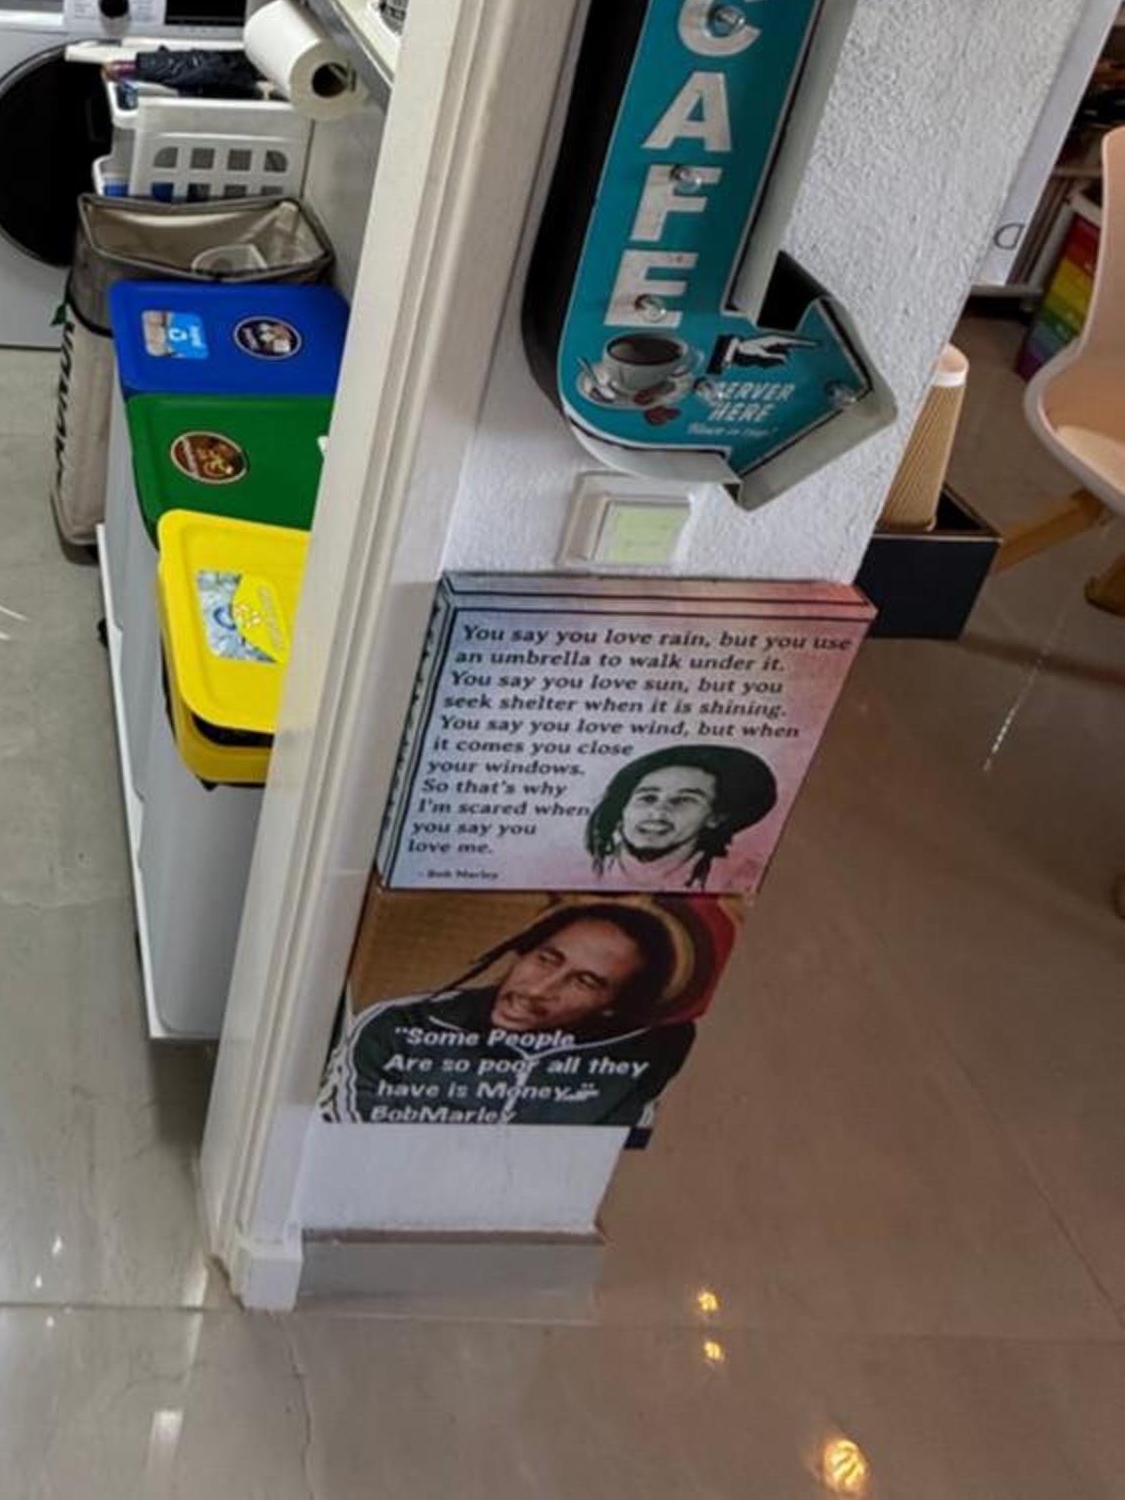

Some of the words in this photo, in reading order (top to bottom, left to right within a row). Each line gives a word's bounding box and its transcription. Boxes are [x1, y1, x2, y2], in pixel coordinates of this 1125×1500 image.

[707, 403, 776, 421] HERE
[463, 625, 504, 642] You
[511, 631, 549, 646] say
[555, 631, 598, 646] you
[604, 627, 653, 645] love
[659, 630, 711, 647] rain,
[719, 631, 757, 647] but
[763, 637, 807, 651] you
[813, 637, 852, 650] use
[455, 652, 483, 665] an
[490, 649, 592, 667] umbrella
[599, 652, 623, 668] to
[629, 654, 682, 669] walk
[689, 655, 756, 671] under
[762, 657, 786, 672] it.
[450, 670, 492, 687] You
[498, 675, 536, 690] say
[541, 676, 584, 691] you
[591, 673, 639, 691] love
[642, 679, 690, 694] sun,
[698, 677, 736, 692] but
[741, 681, 784, 696] you
[443, 693, 493, 709] seek
[499, 694, 578, 711] shelter
[584, 696, 644, 713] when
[649, 699, 668, 713] it
[673, 700, 693, 714] is
[698, 700, 788, 720] shining.
[440, 715, 481, 731] You
[486, 719, 524, 735] say
[529, 720, 570, 736] you
[576, 717, 624, 734] love
[630, 720, 689, 738] wind,
[697, 721, 736, 737] but
[741, 723, 801, 738] when
[432, 737, 450, 751] it
[455, 739, 526, 753] comes
[530, 741, 572, 756] you
[577, 739, 635, 756] close
[426, 760, 479, 776] your
[485, 759, 586, 776] windows.
[421, 779, 450, 794] So
[456, 779, 516, 795] that's
[523, 780, 570, 797] why
[418, 798, 452, 814] I'm
[458, 801, 528, 816] scared
[534, 801, 591, 816] when
[411, 822, 452, 835] you
[457, 822, 493, 837] say
[498, 821, 538, 836] you
[407, 838, 452, 853] love
[457, 842, 495, 854] me.
[486, 1027, 577, 1050] People
[382, 1053, 433, 1073] Are
[441, 1057, 472, 1073] so
[476, 1057, 540, 1077] poor
[546, 1055, 580, 1075] all
[588, 1055, 651, 1078] they
[377, 1079, 440, 1099] have
[447, 1080, 468, 1099] is
